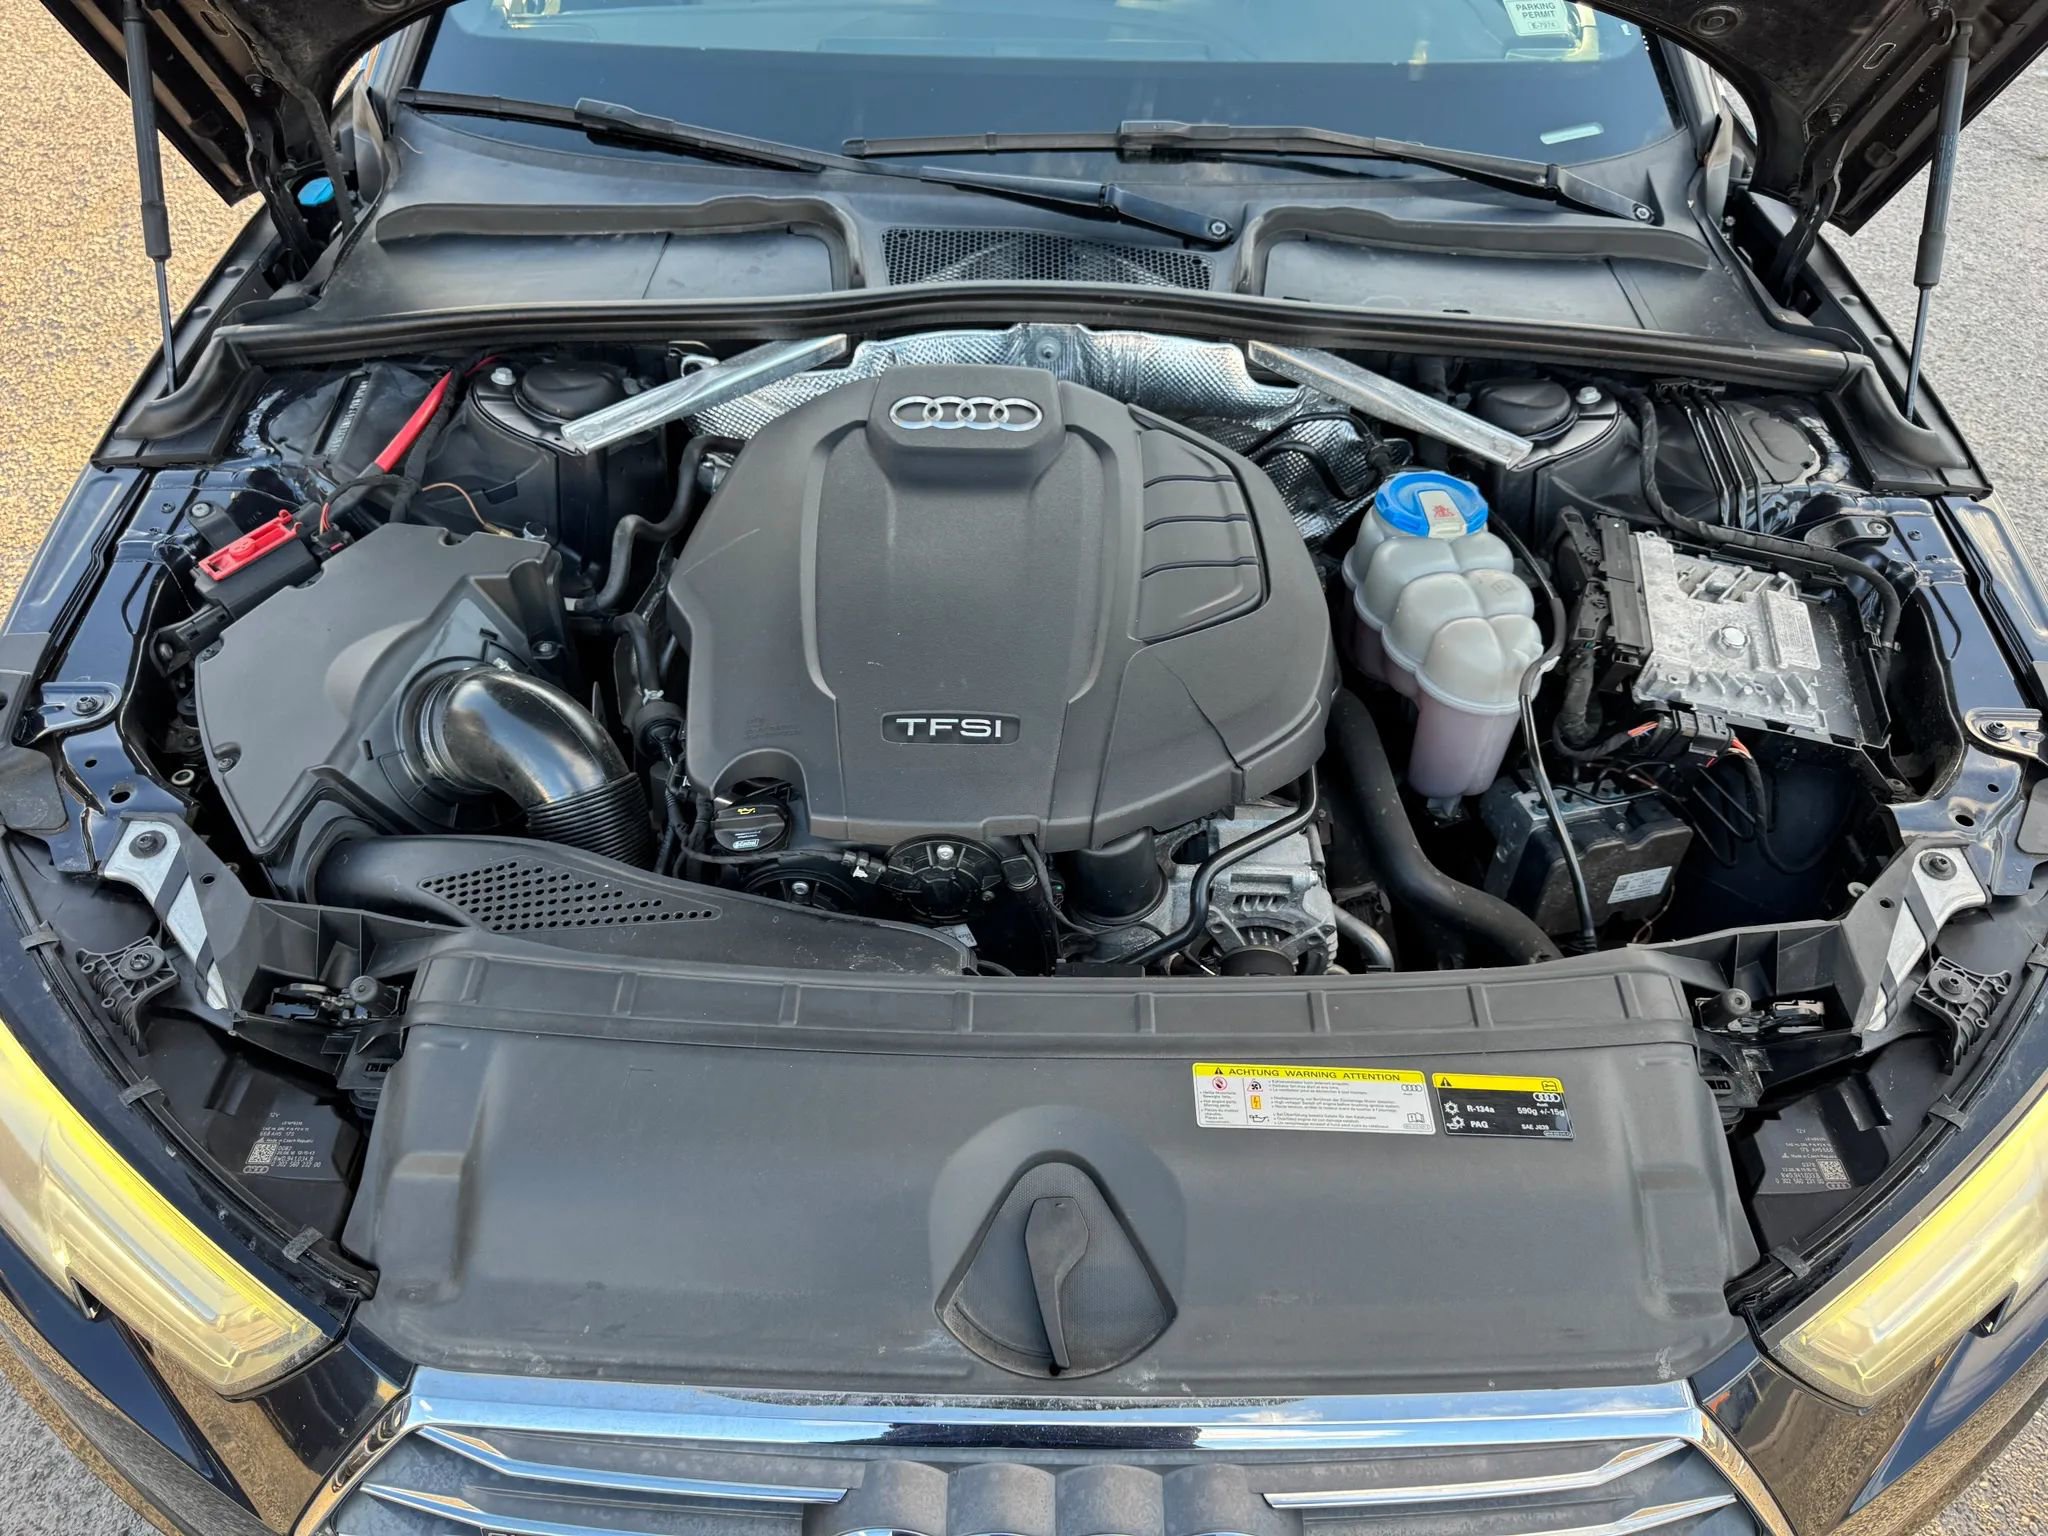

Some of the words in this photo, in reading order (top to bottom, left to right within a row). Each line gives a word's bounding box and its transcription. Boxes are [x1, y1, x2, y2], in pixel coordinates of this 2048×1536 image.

[1516, 2, 1556, 11] PARKING
[1522, 10, 1556, 19] PERMIT
[896, 718, 1002, 738] TFSI
[1228, 1068, 1280, 1077] ACHTUNG
[1285, 1070, 1337, 1079] WARNING
[1343, 1072, 1400, 1081] ATTENTION
[1466, 1105, 1495, 1113] R-134a
[1470, 1120, 1488, 1129] PAG
